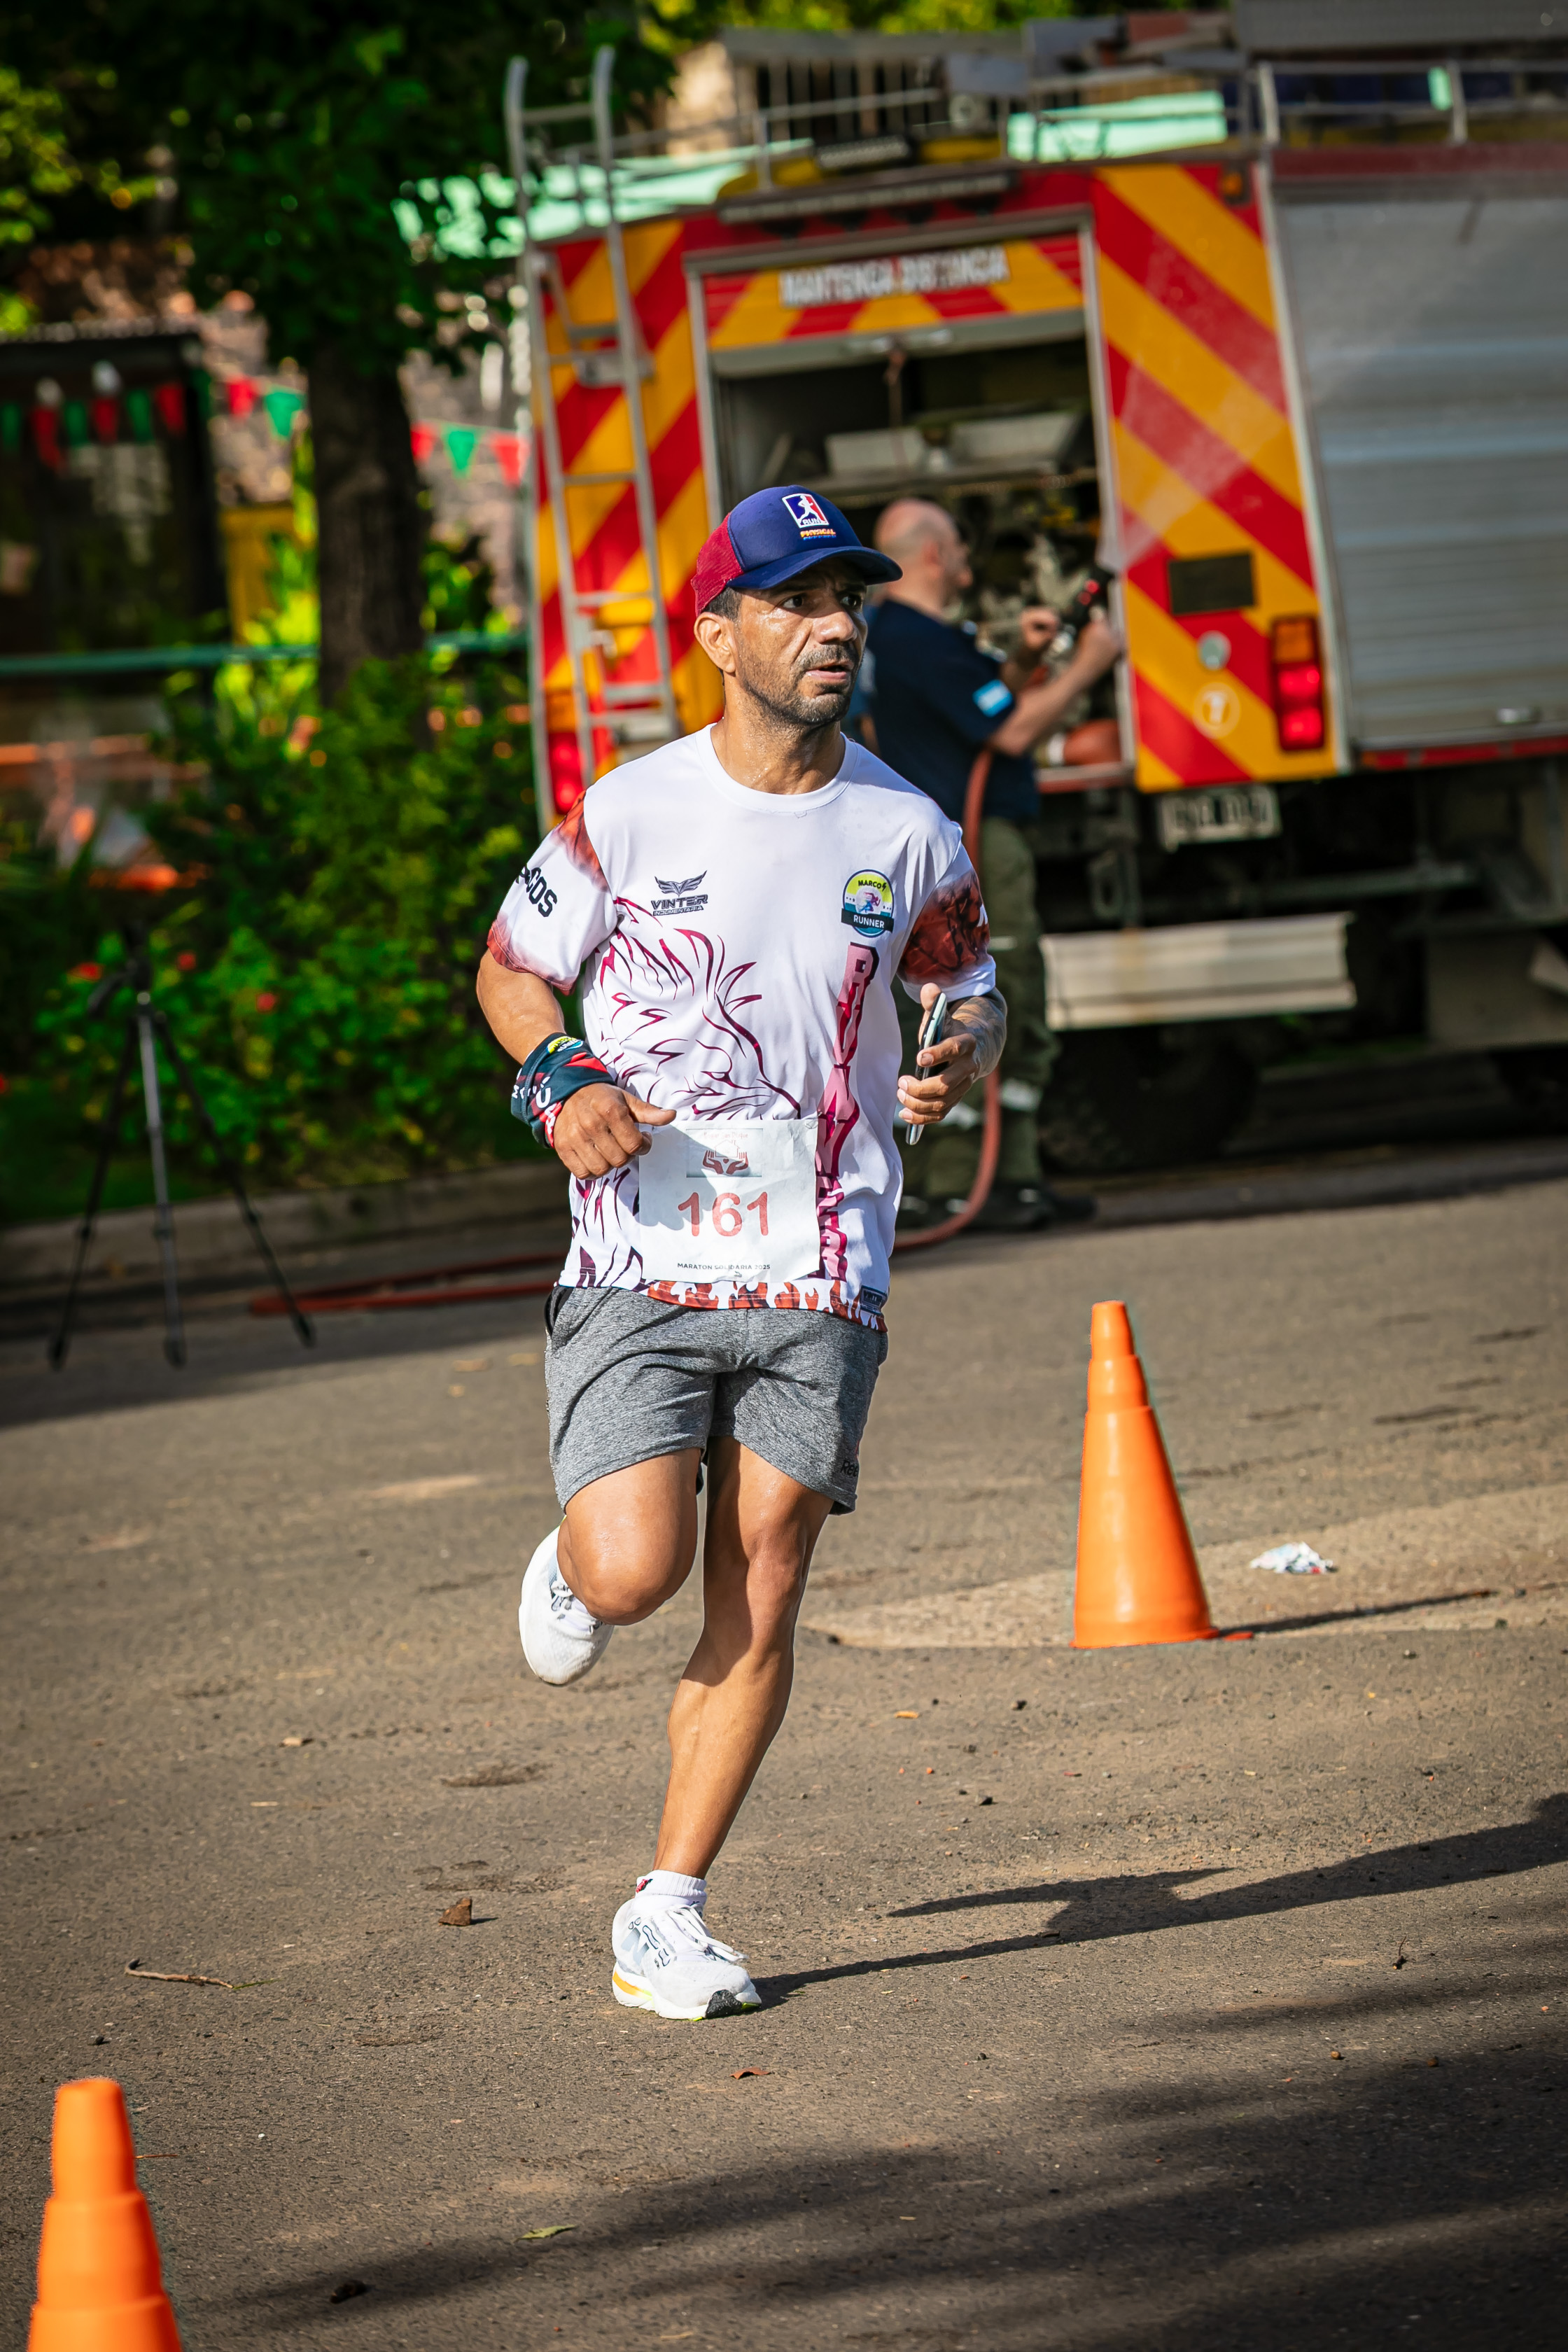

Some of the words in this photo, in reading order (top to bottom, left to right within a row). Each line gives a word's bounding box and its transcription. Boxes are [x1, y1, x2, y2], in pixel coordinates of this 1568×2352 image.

[800, 528, 836, 538] PHYSICAL
[651, 895, 708, 910] VINTER
[854, 915, 884, 928] RUNNER
[678, 1191, 769, 1237] 161
